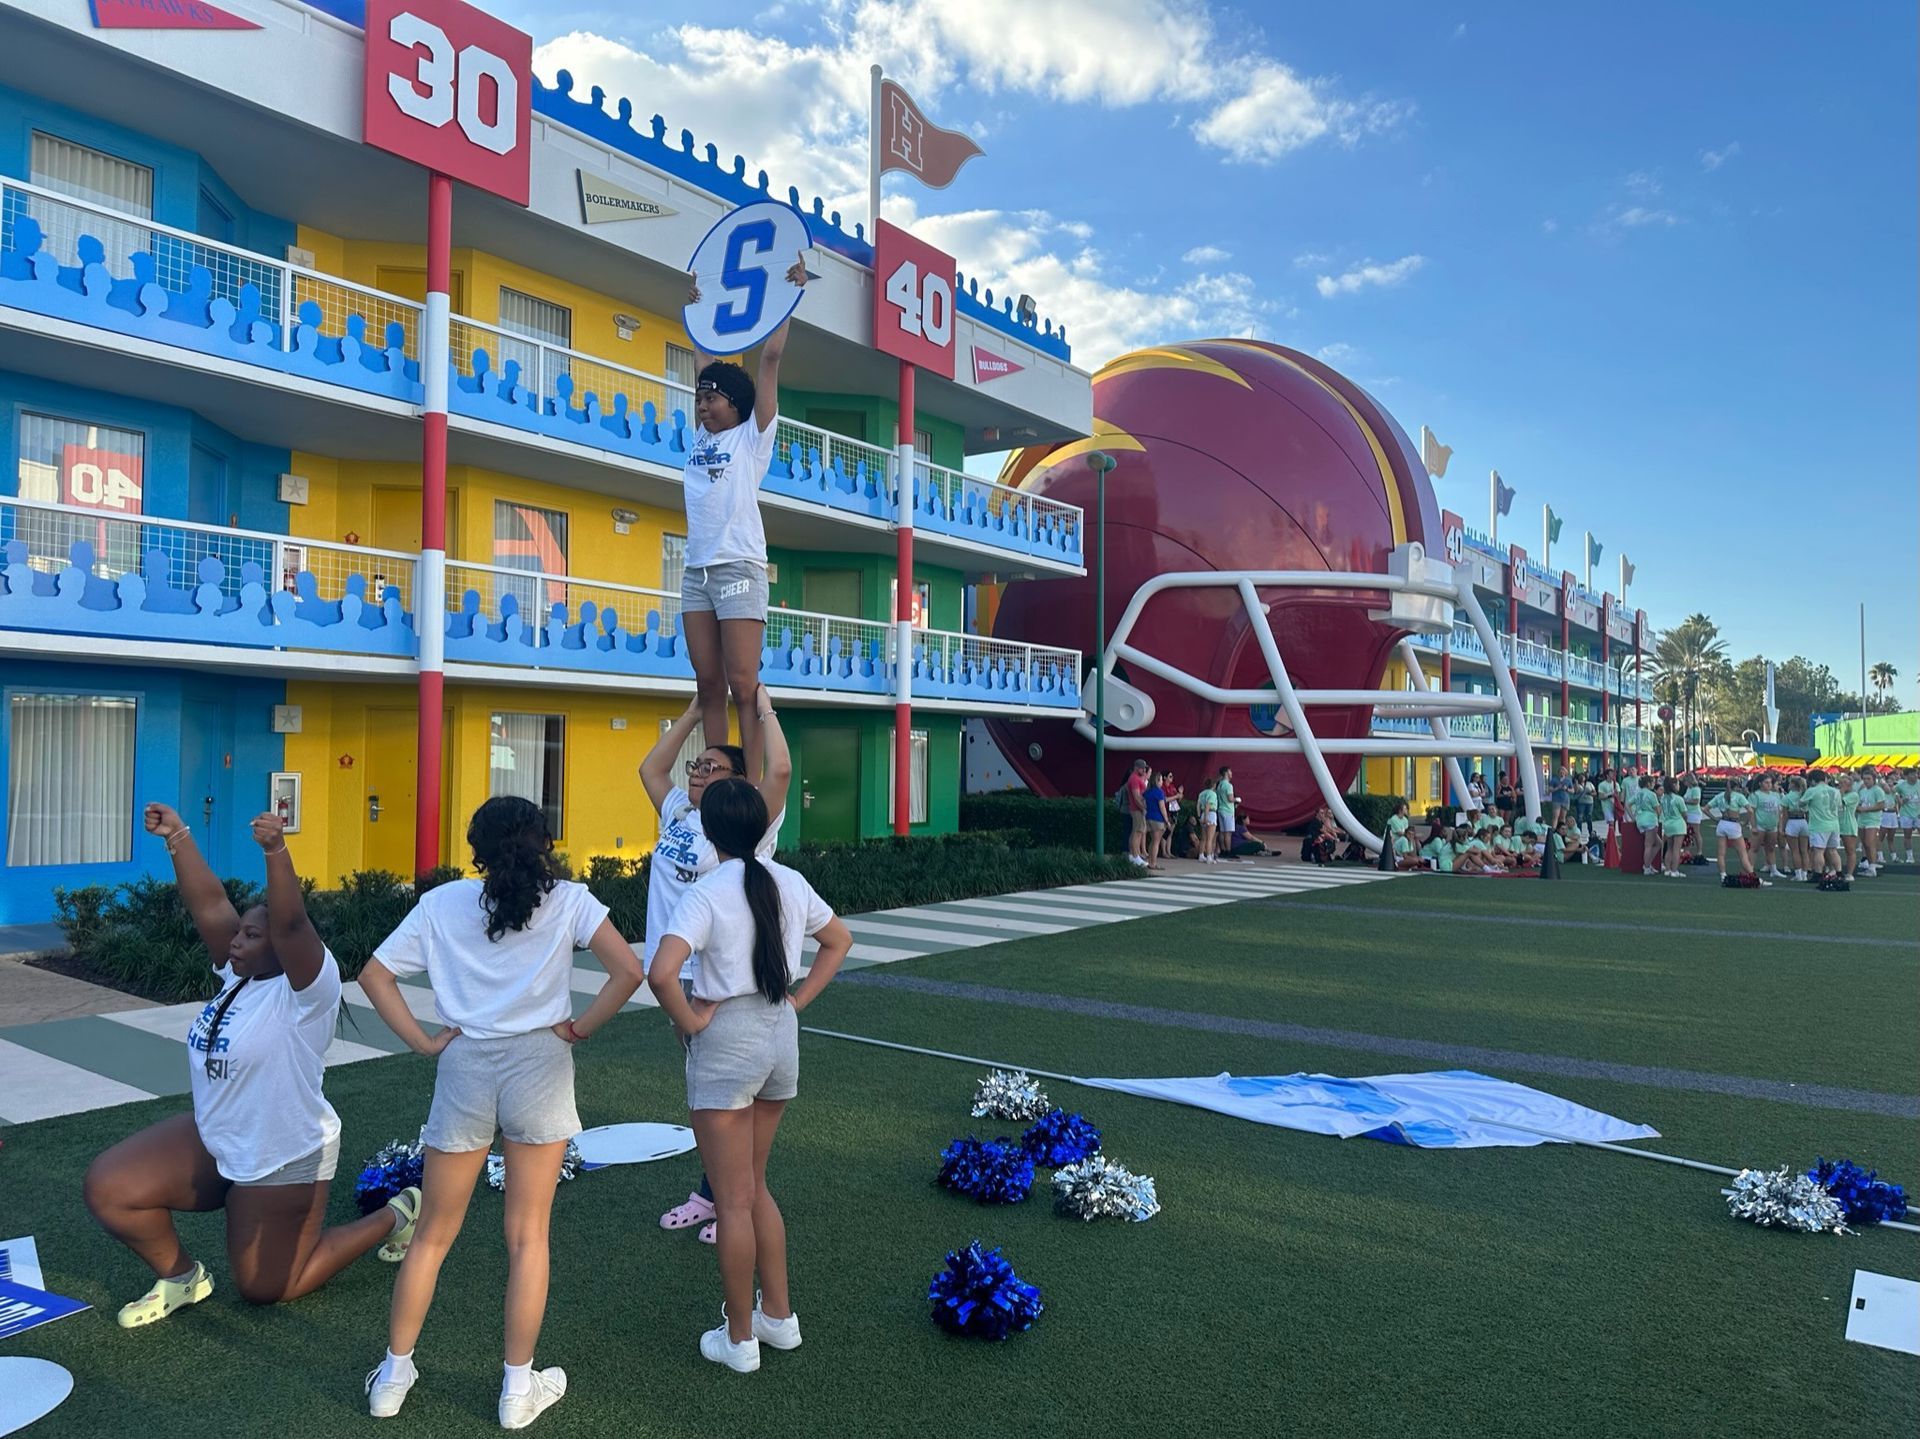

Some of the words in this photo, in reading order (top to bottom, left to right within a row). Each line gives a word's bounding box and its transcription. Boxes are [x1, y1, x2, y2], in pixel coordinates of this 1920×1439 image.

[388, 11, 518, 156] 30
[890, 90, 923, 172] H
[584, 192, 660, 215] BOILERMAKERS
[712, 218, 777, 336] S
[886, 260, 952, 348] 40
[978, 359, 1009, 372] BULLDOGS
[1445, 525, 1464, 564] 40
[720, 579, 750, 600] CHEER
[1512, 556, 1527, 590] 30
